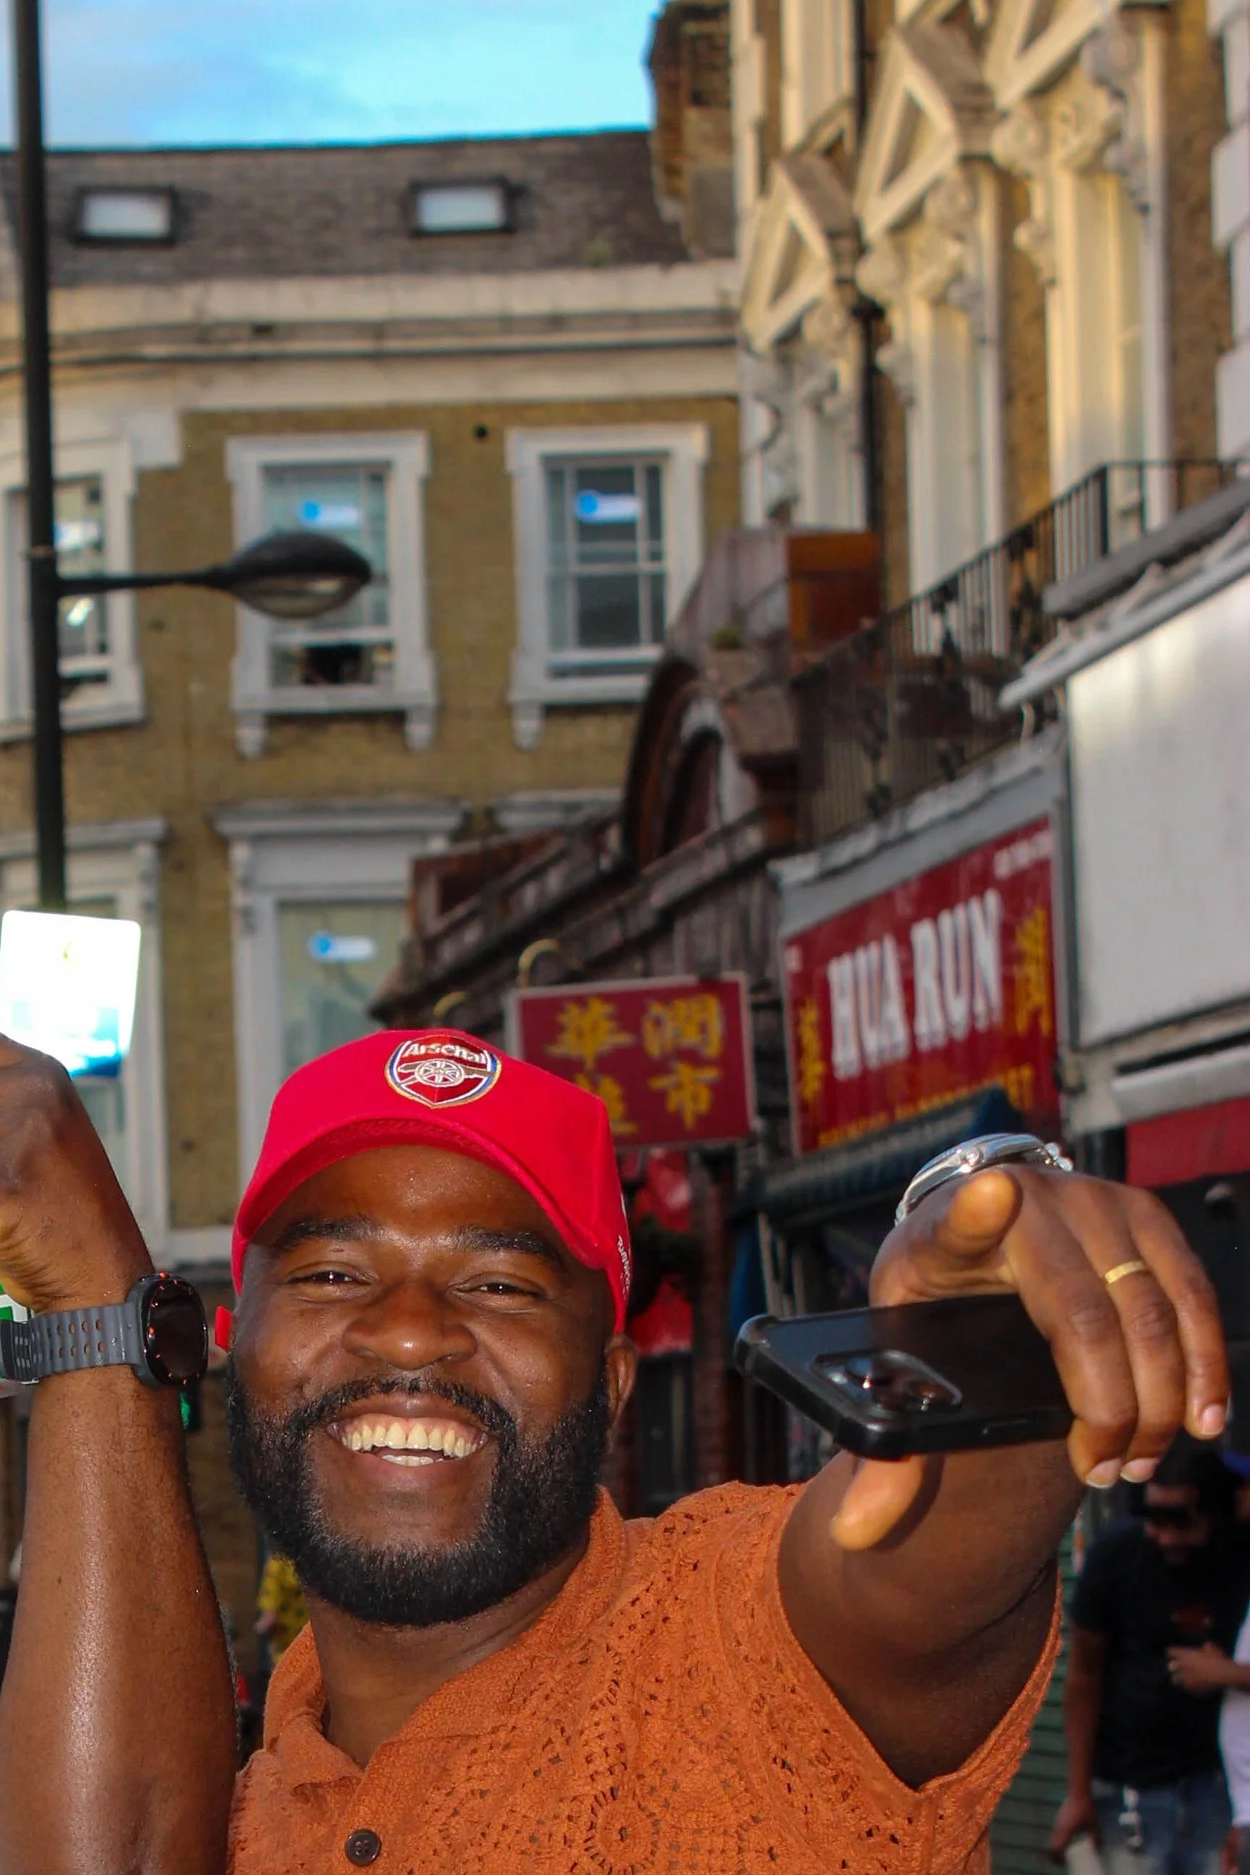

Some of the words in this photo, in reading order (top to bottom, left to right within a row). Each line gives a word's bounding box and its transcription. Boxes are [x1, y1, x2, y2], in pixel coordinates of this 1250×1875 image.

[827, 932, 910, 1082] HUA
[910, 886, 1003, 1053] RUN
[402, 1042, 488, 1065] Arsenal
